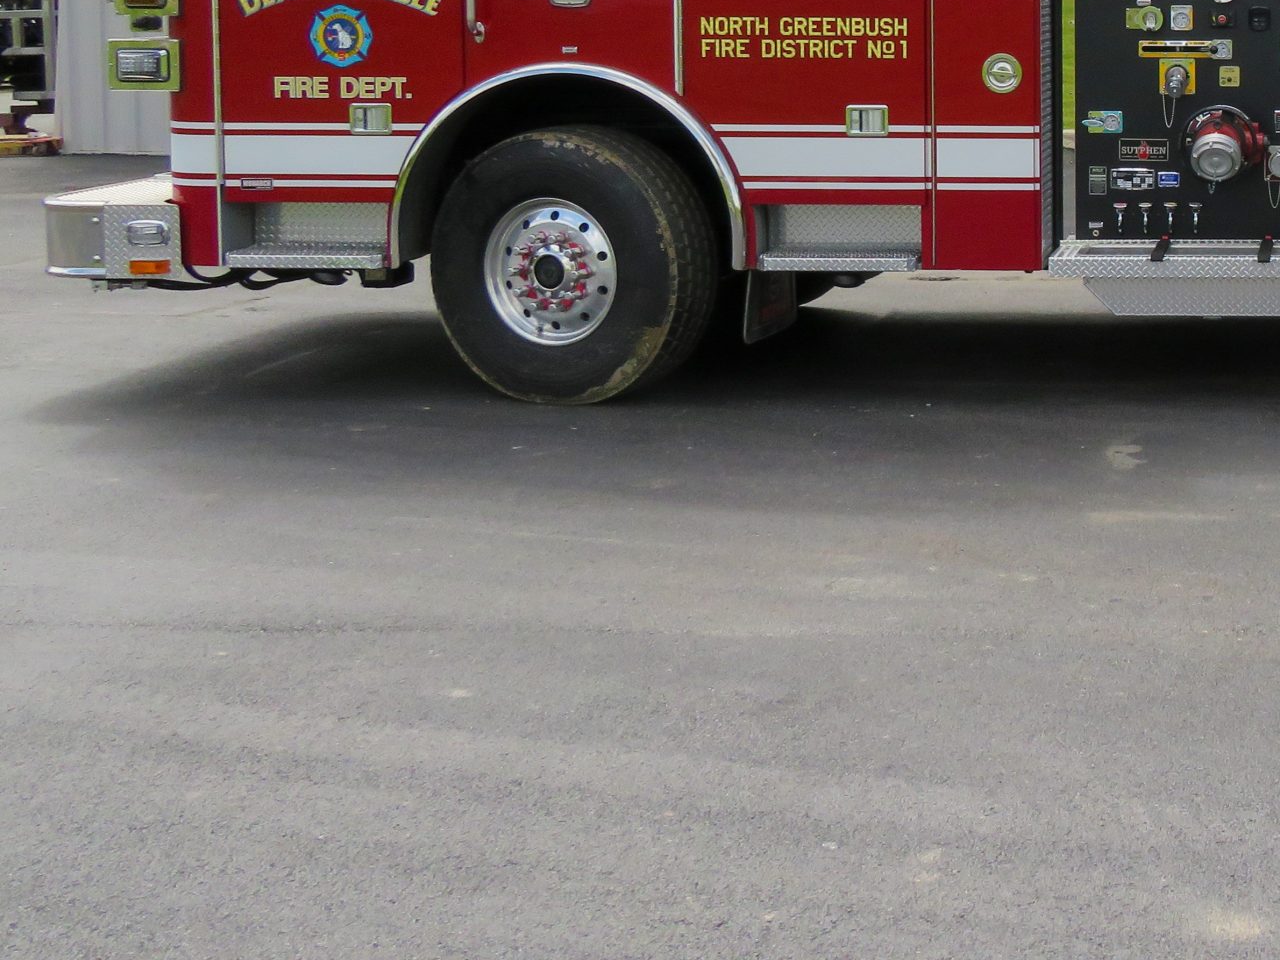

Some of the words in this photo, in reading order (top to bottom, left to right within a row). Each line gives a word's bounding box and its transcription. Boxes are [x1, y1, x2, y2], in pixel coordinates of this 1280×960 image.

[700, 16, 769, 36] NORTH
[779, 17, 908, 37] GREENBUSH
[701, 39, 750, 58] FIRE
[761, 40, 857, 59] DISTRICT
[273, 76, 330, 99] FIRE
[340, 76, 413, 99] DEPT.
[1121, 146, 1167, 155] SUTPHEN
